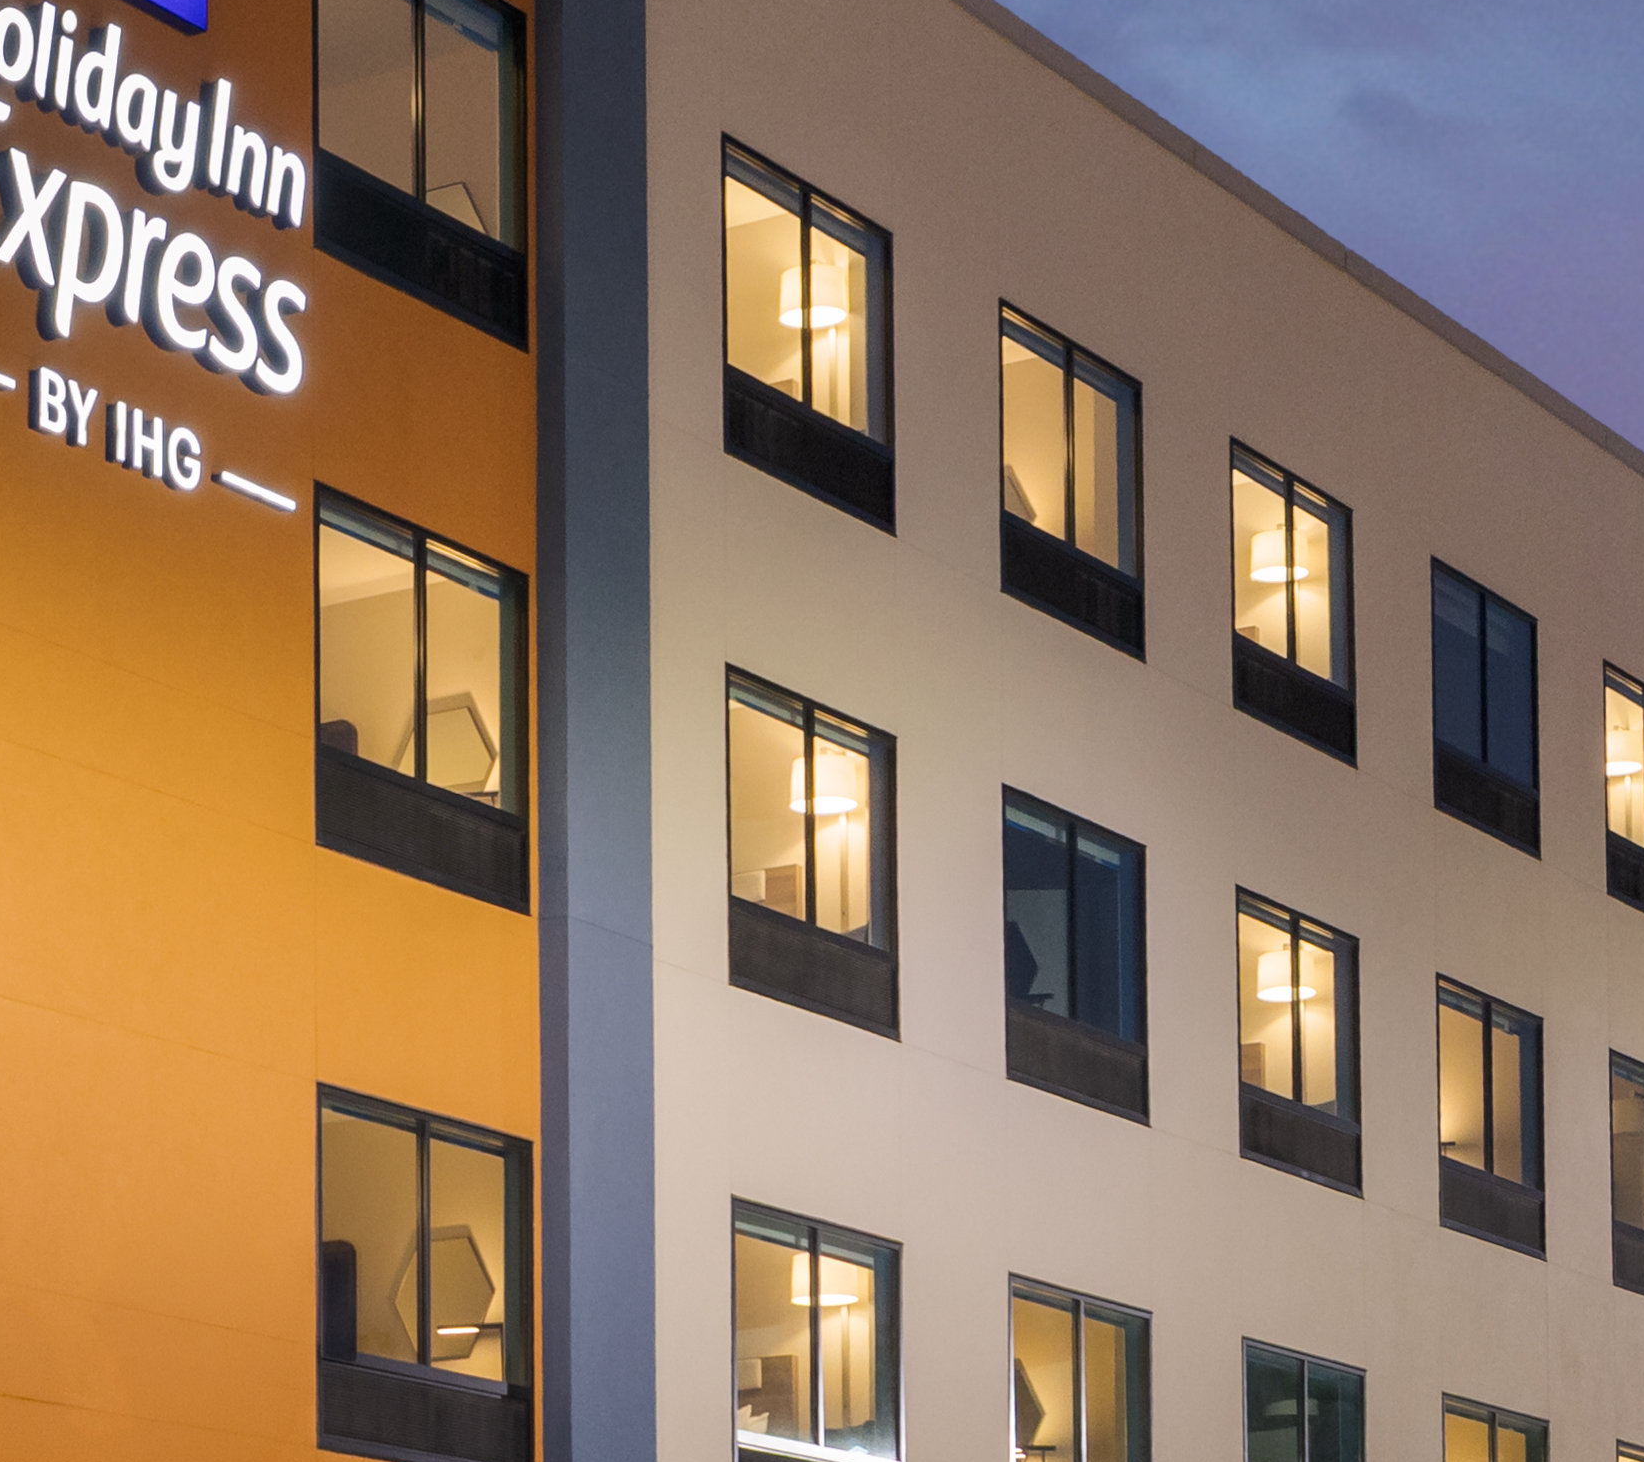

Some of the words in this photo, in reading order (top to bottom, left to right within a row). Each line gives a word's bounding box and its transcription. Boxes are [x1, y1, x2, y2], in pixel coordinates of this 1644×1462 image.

[208, 77, 307, 228] Inn
[38, 365, 100, 447] BY
[115, 399, 203, 492] IHG
